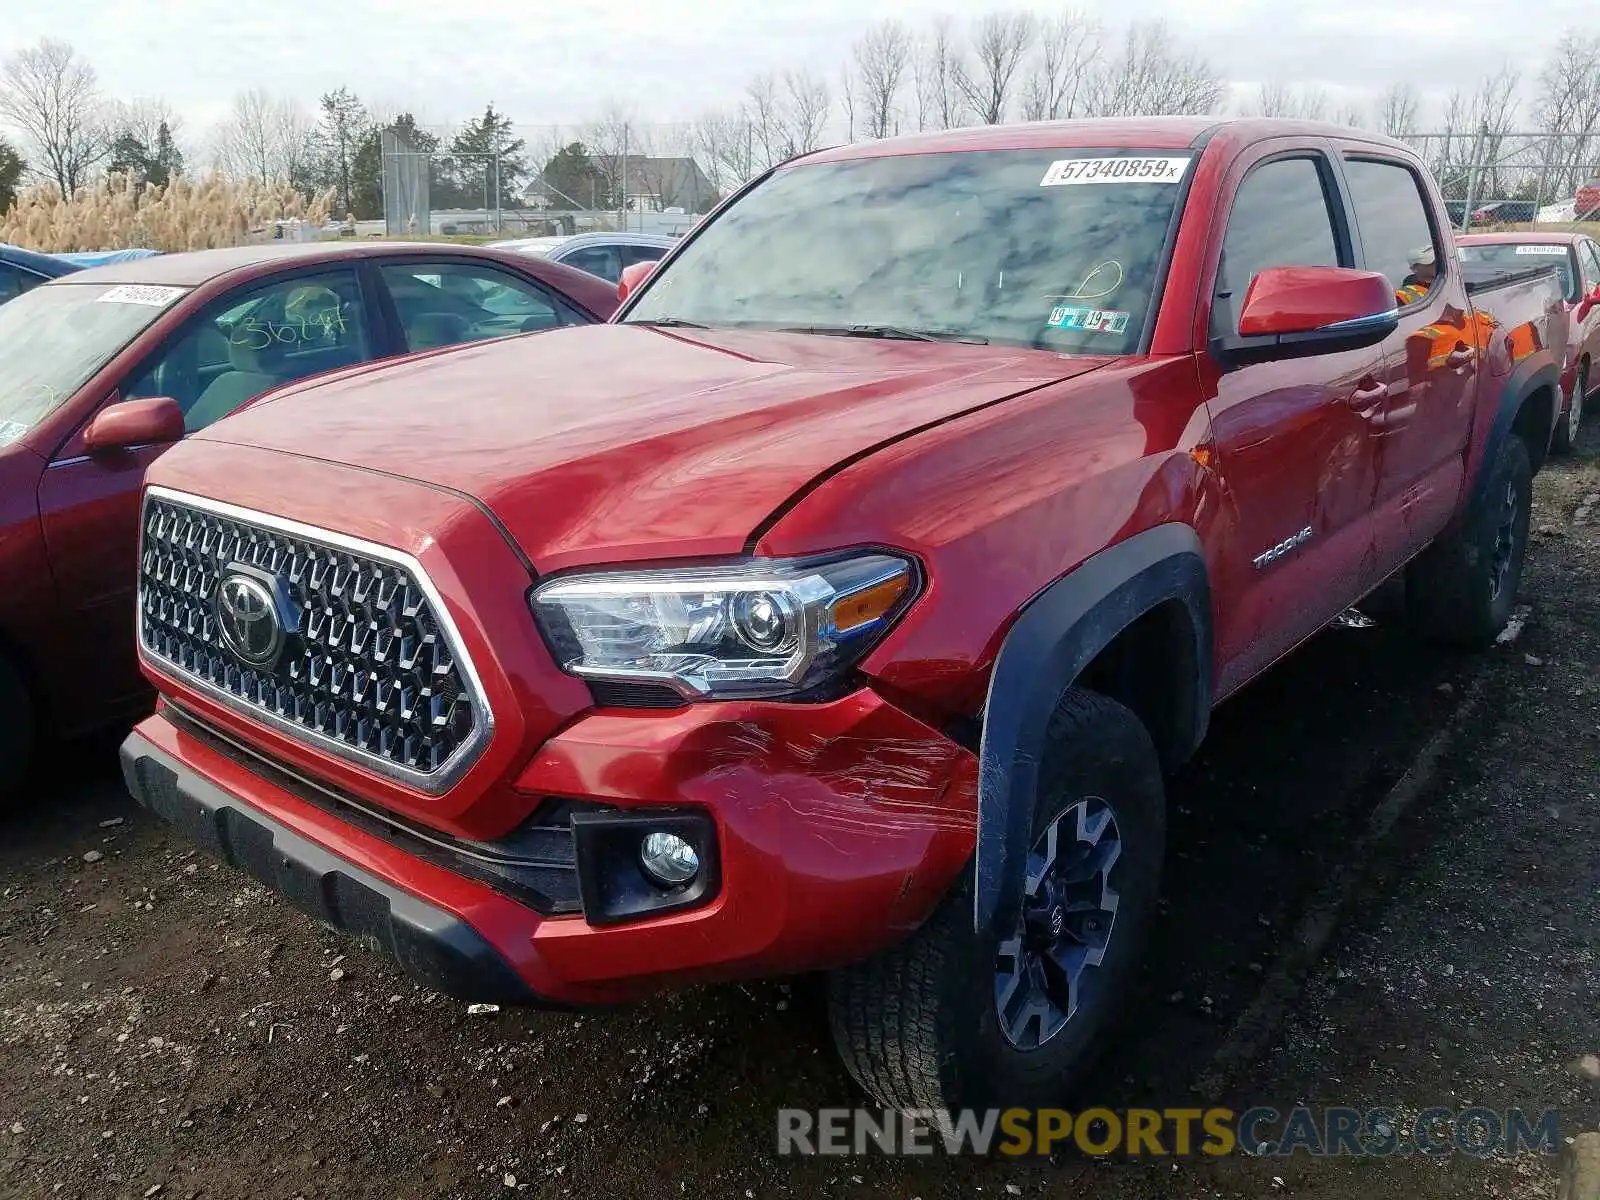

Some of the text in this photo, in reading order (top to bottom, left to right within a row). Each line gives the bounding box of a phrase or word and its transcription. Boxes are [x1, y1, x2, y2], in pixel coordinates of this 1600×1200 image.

[1050, 308, 1066, 323] 19
[1087, 311, 1103, 326] 19
[1253, 527, 1312, 569] TACOMA
